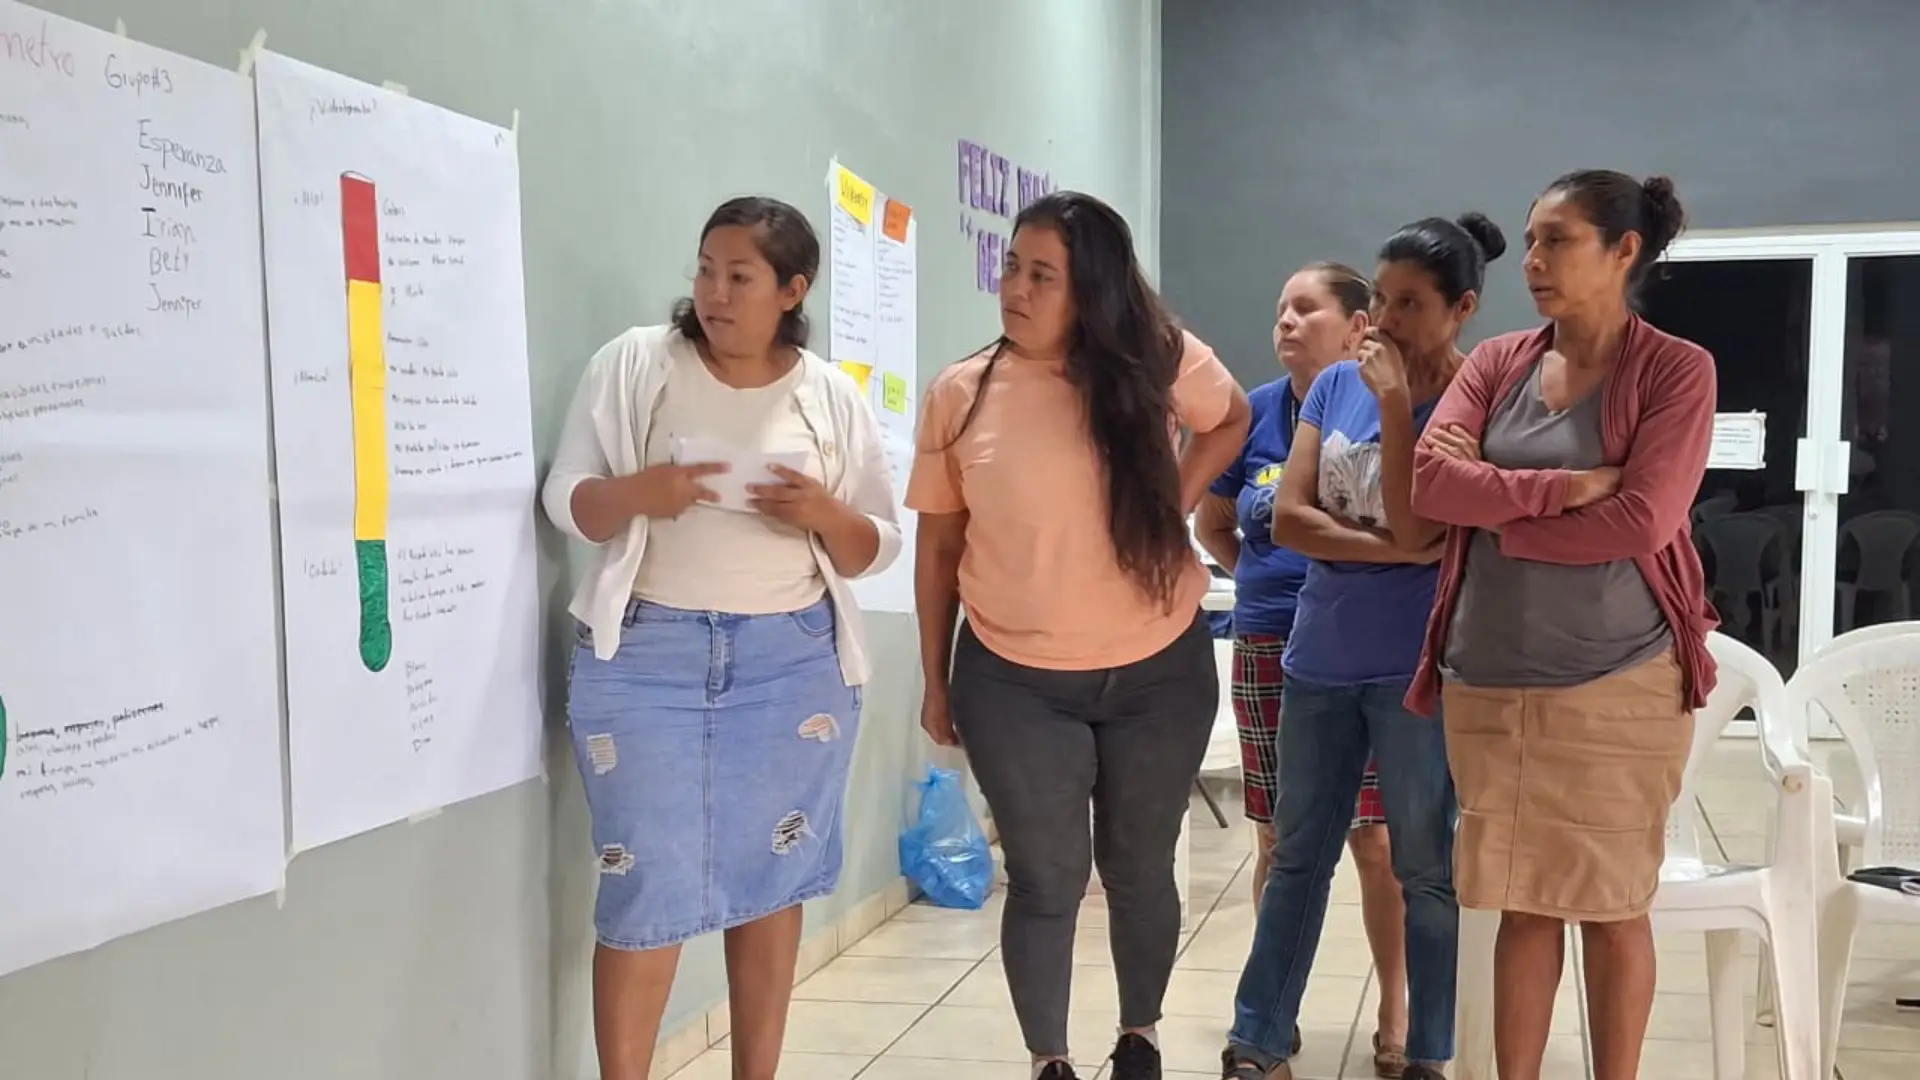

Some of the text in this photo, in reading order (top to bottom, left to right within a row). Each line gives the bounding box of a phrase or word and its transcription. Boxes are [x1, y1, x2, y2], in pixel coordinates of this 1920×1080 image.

[138, 119, 226, 173] Esperanza
[139, 163, 204, 207] Jennifer
[957, 138, 1009, 218] FELIZ
